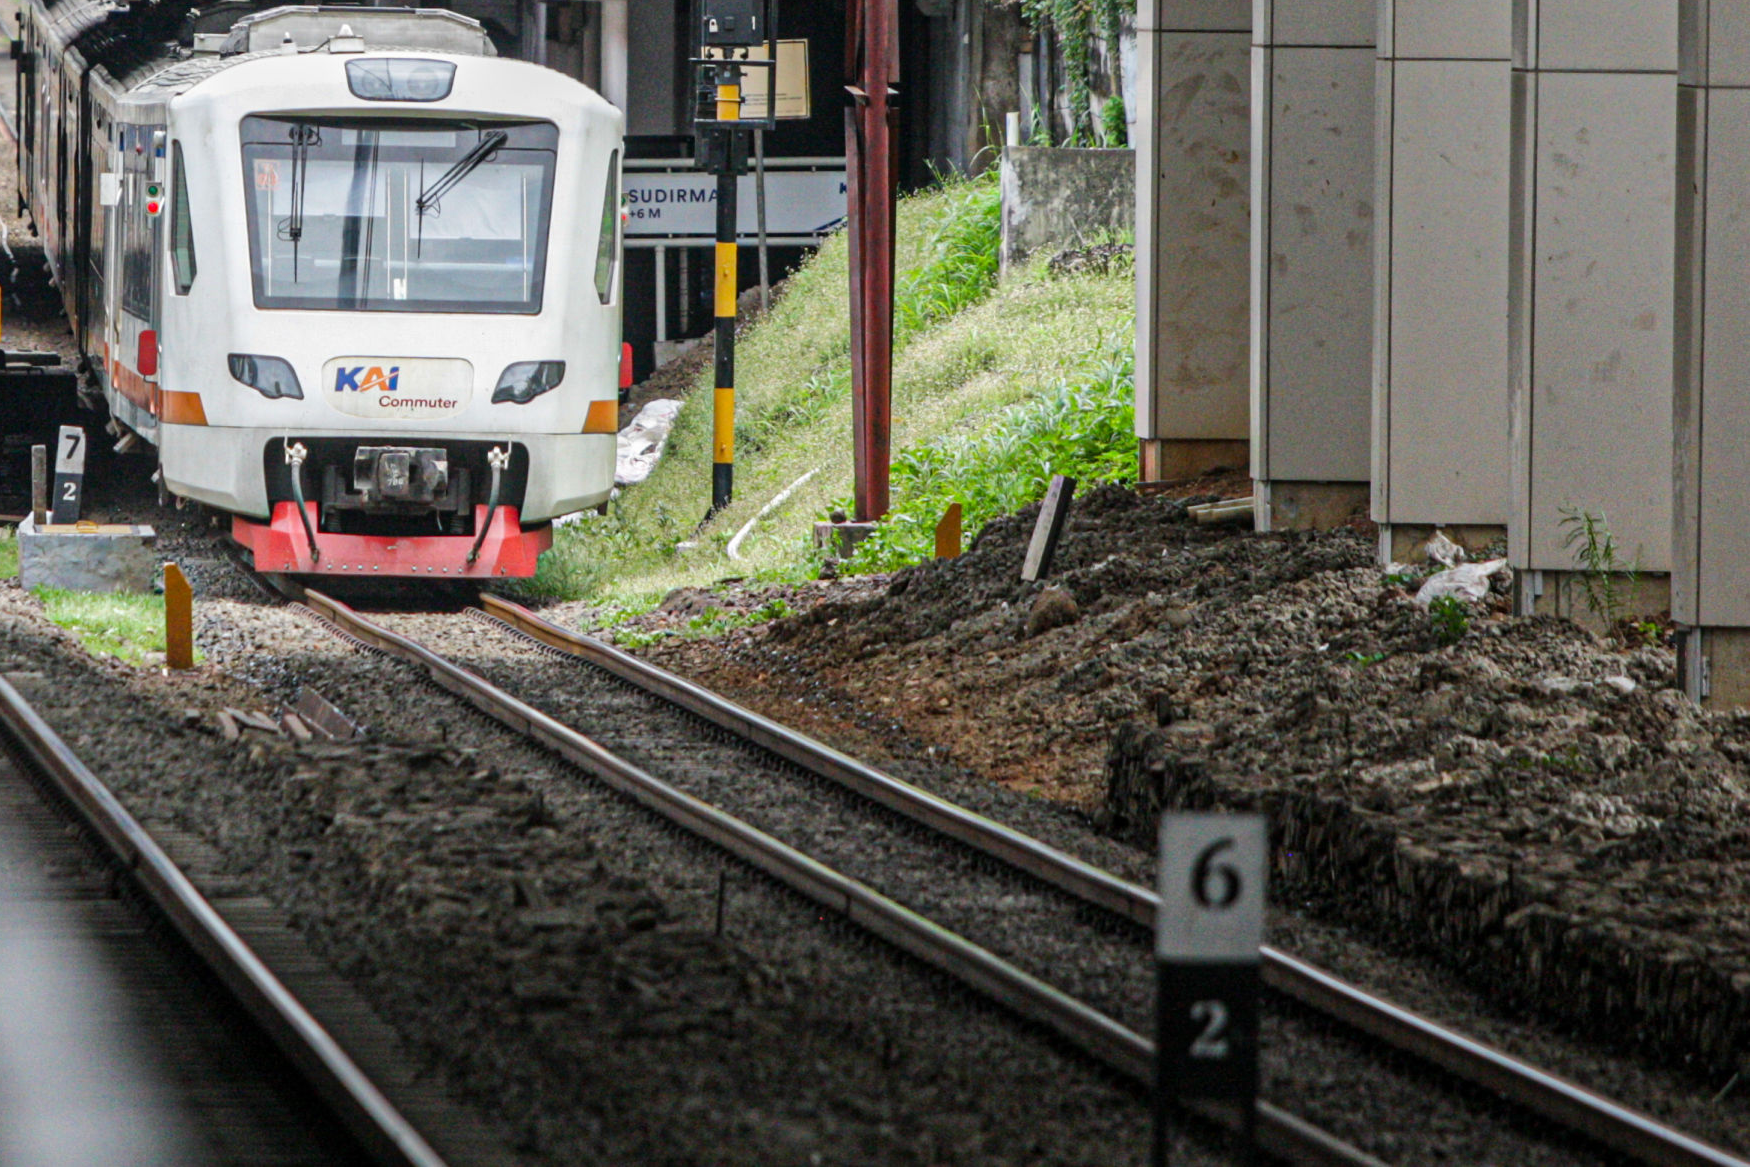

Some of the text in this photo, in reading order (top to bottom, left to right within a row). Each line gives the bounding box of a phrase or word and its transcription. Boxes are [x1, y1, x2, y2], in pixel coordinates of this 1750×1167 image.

[628, 188, 717, 203] SUDIRMA
[628, 208, 661, 219] +6 M
[335, 366, 400, 392] KAI
[378, 395, 458, 409] Commuter
[65, 434, 81, 459] 7
[62, 482, 77, 501] 2
[1191, 836, 1242, 909] 6
[1189, 1000, 1229, 1059] 2
